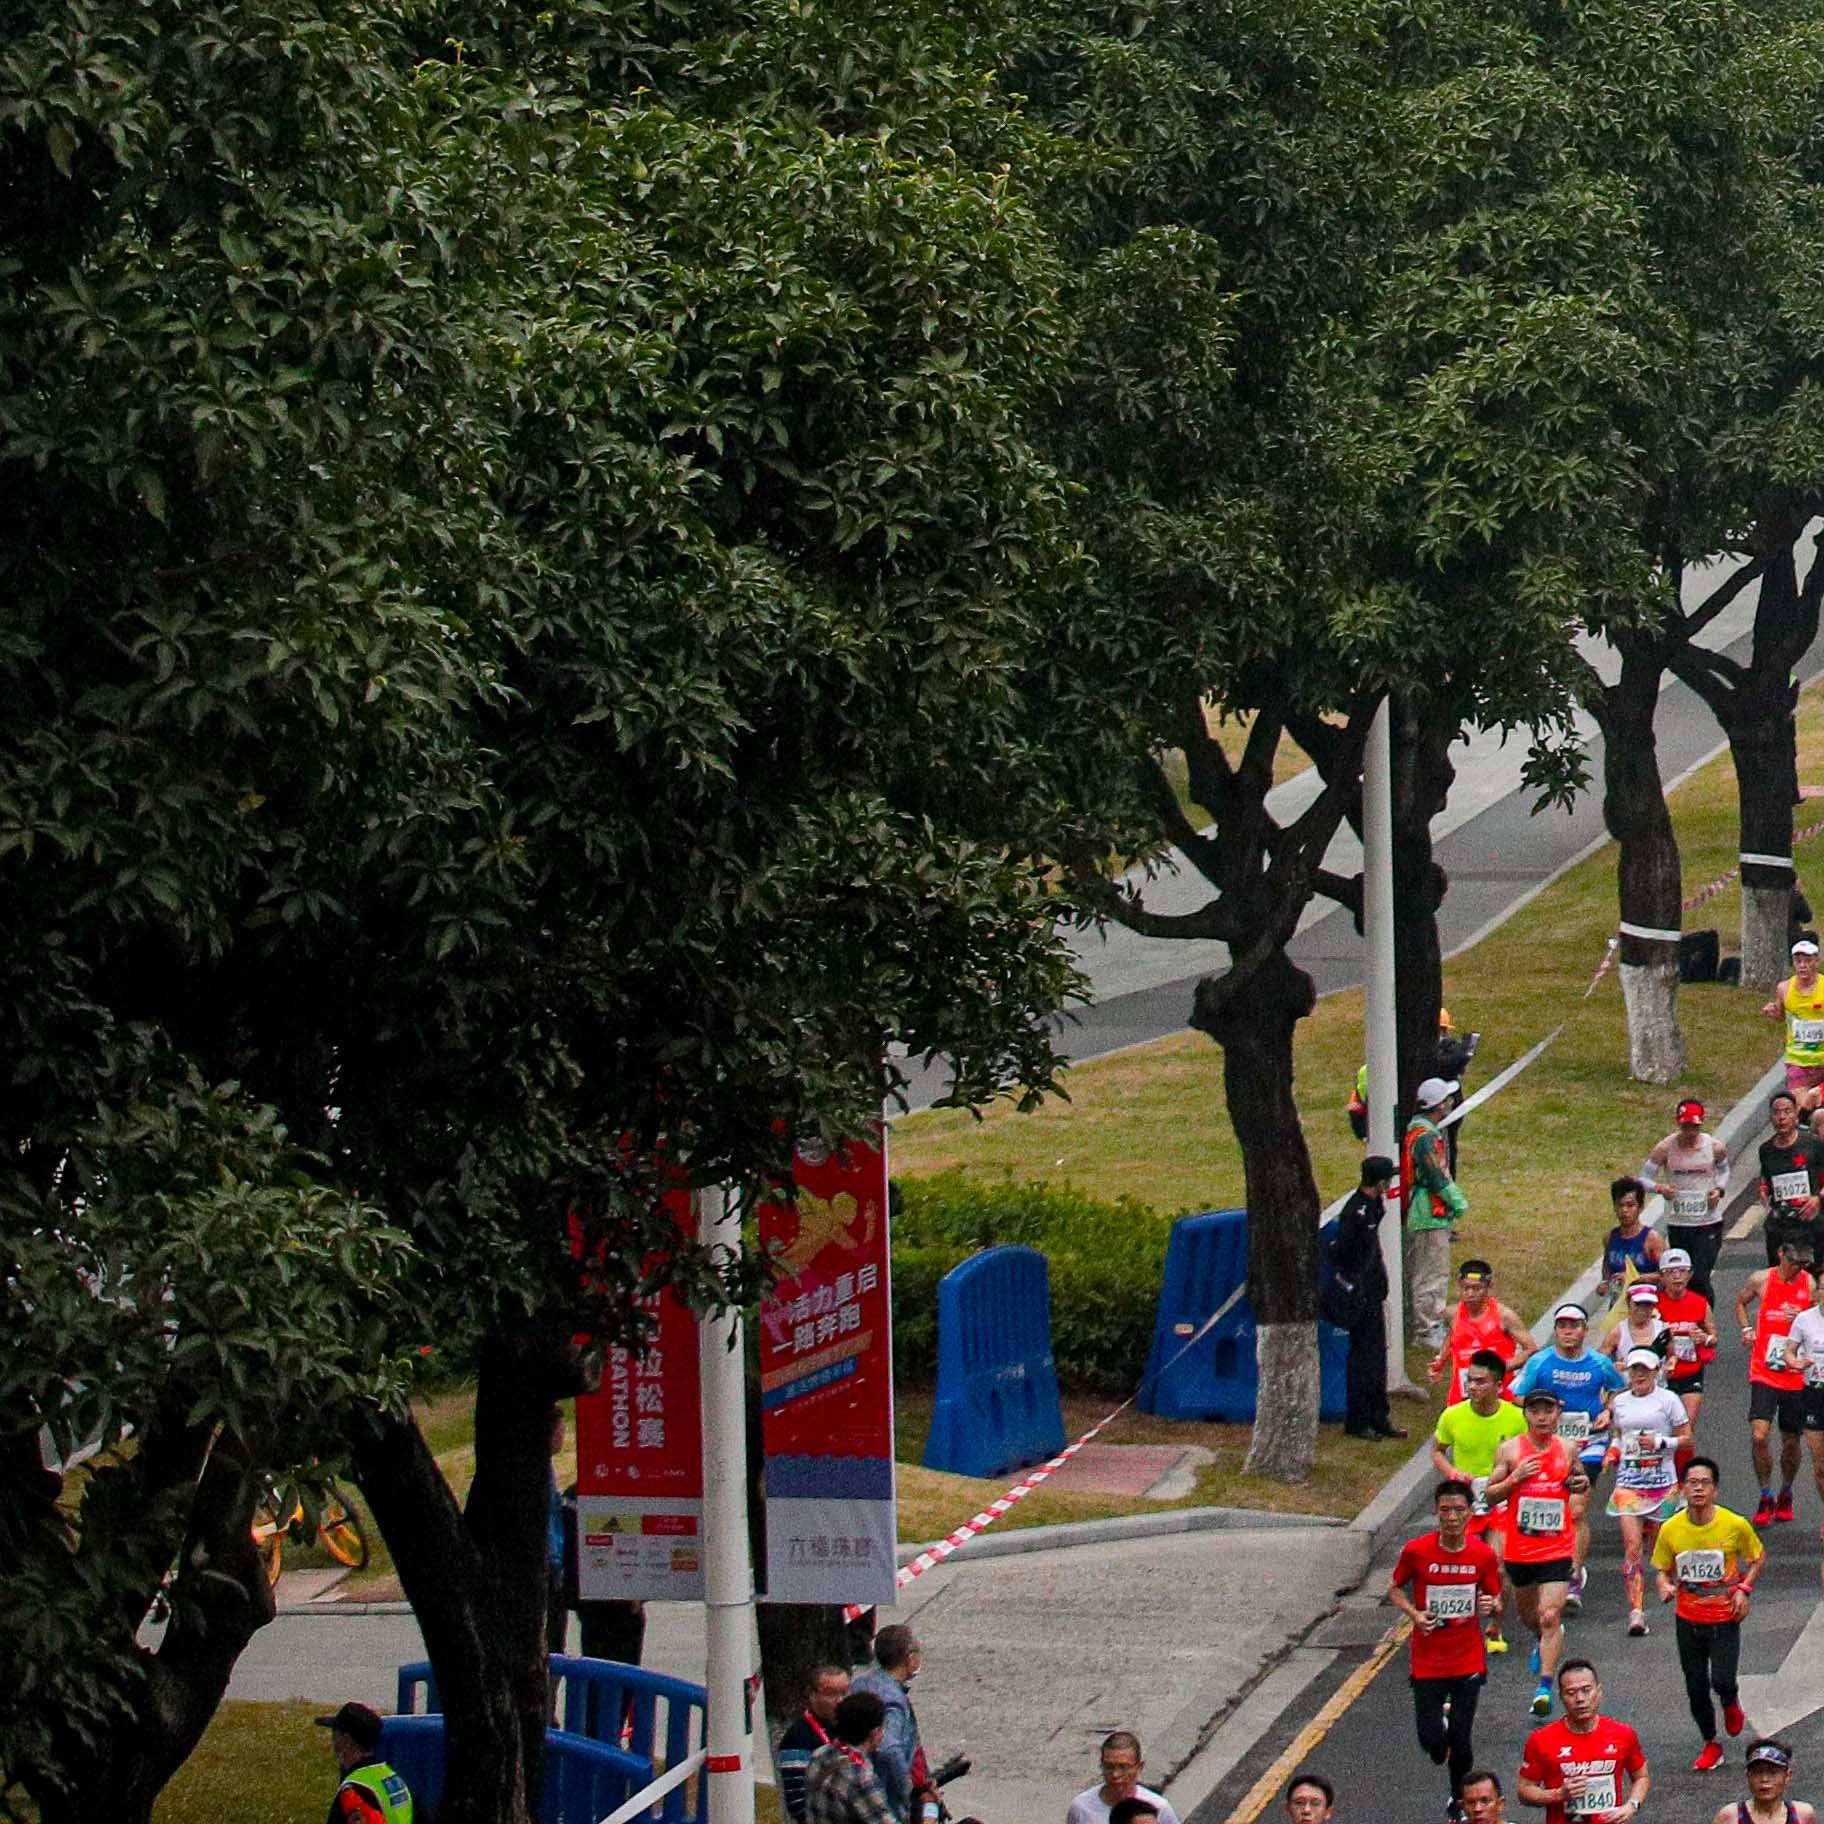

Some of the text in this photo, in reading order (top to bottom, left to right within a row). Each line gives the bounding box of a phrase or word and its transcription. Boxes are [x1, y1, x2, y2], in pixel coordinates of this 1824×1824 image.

[789, 1262, 878, 1323] 活力重启
[771, 1303, 861, 1353] 一路奔跑
[1520, 1512, 1560, 1528] B1130
[1681, 1564, 1722, 1578] A1624
[1430, 1599, 1473, 1614] B0524
